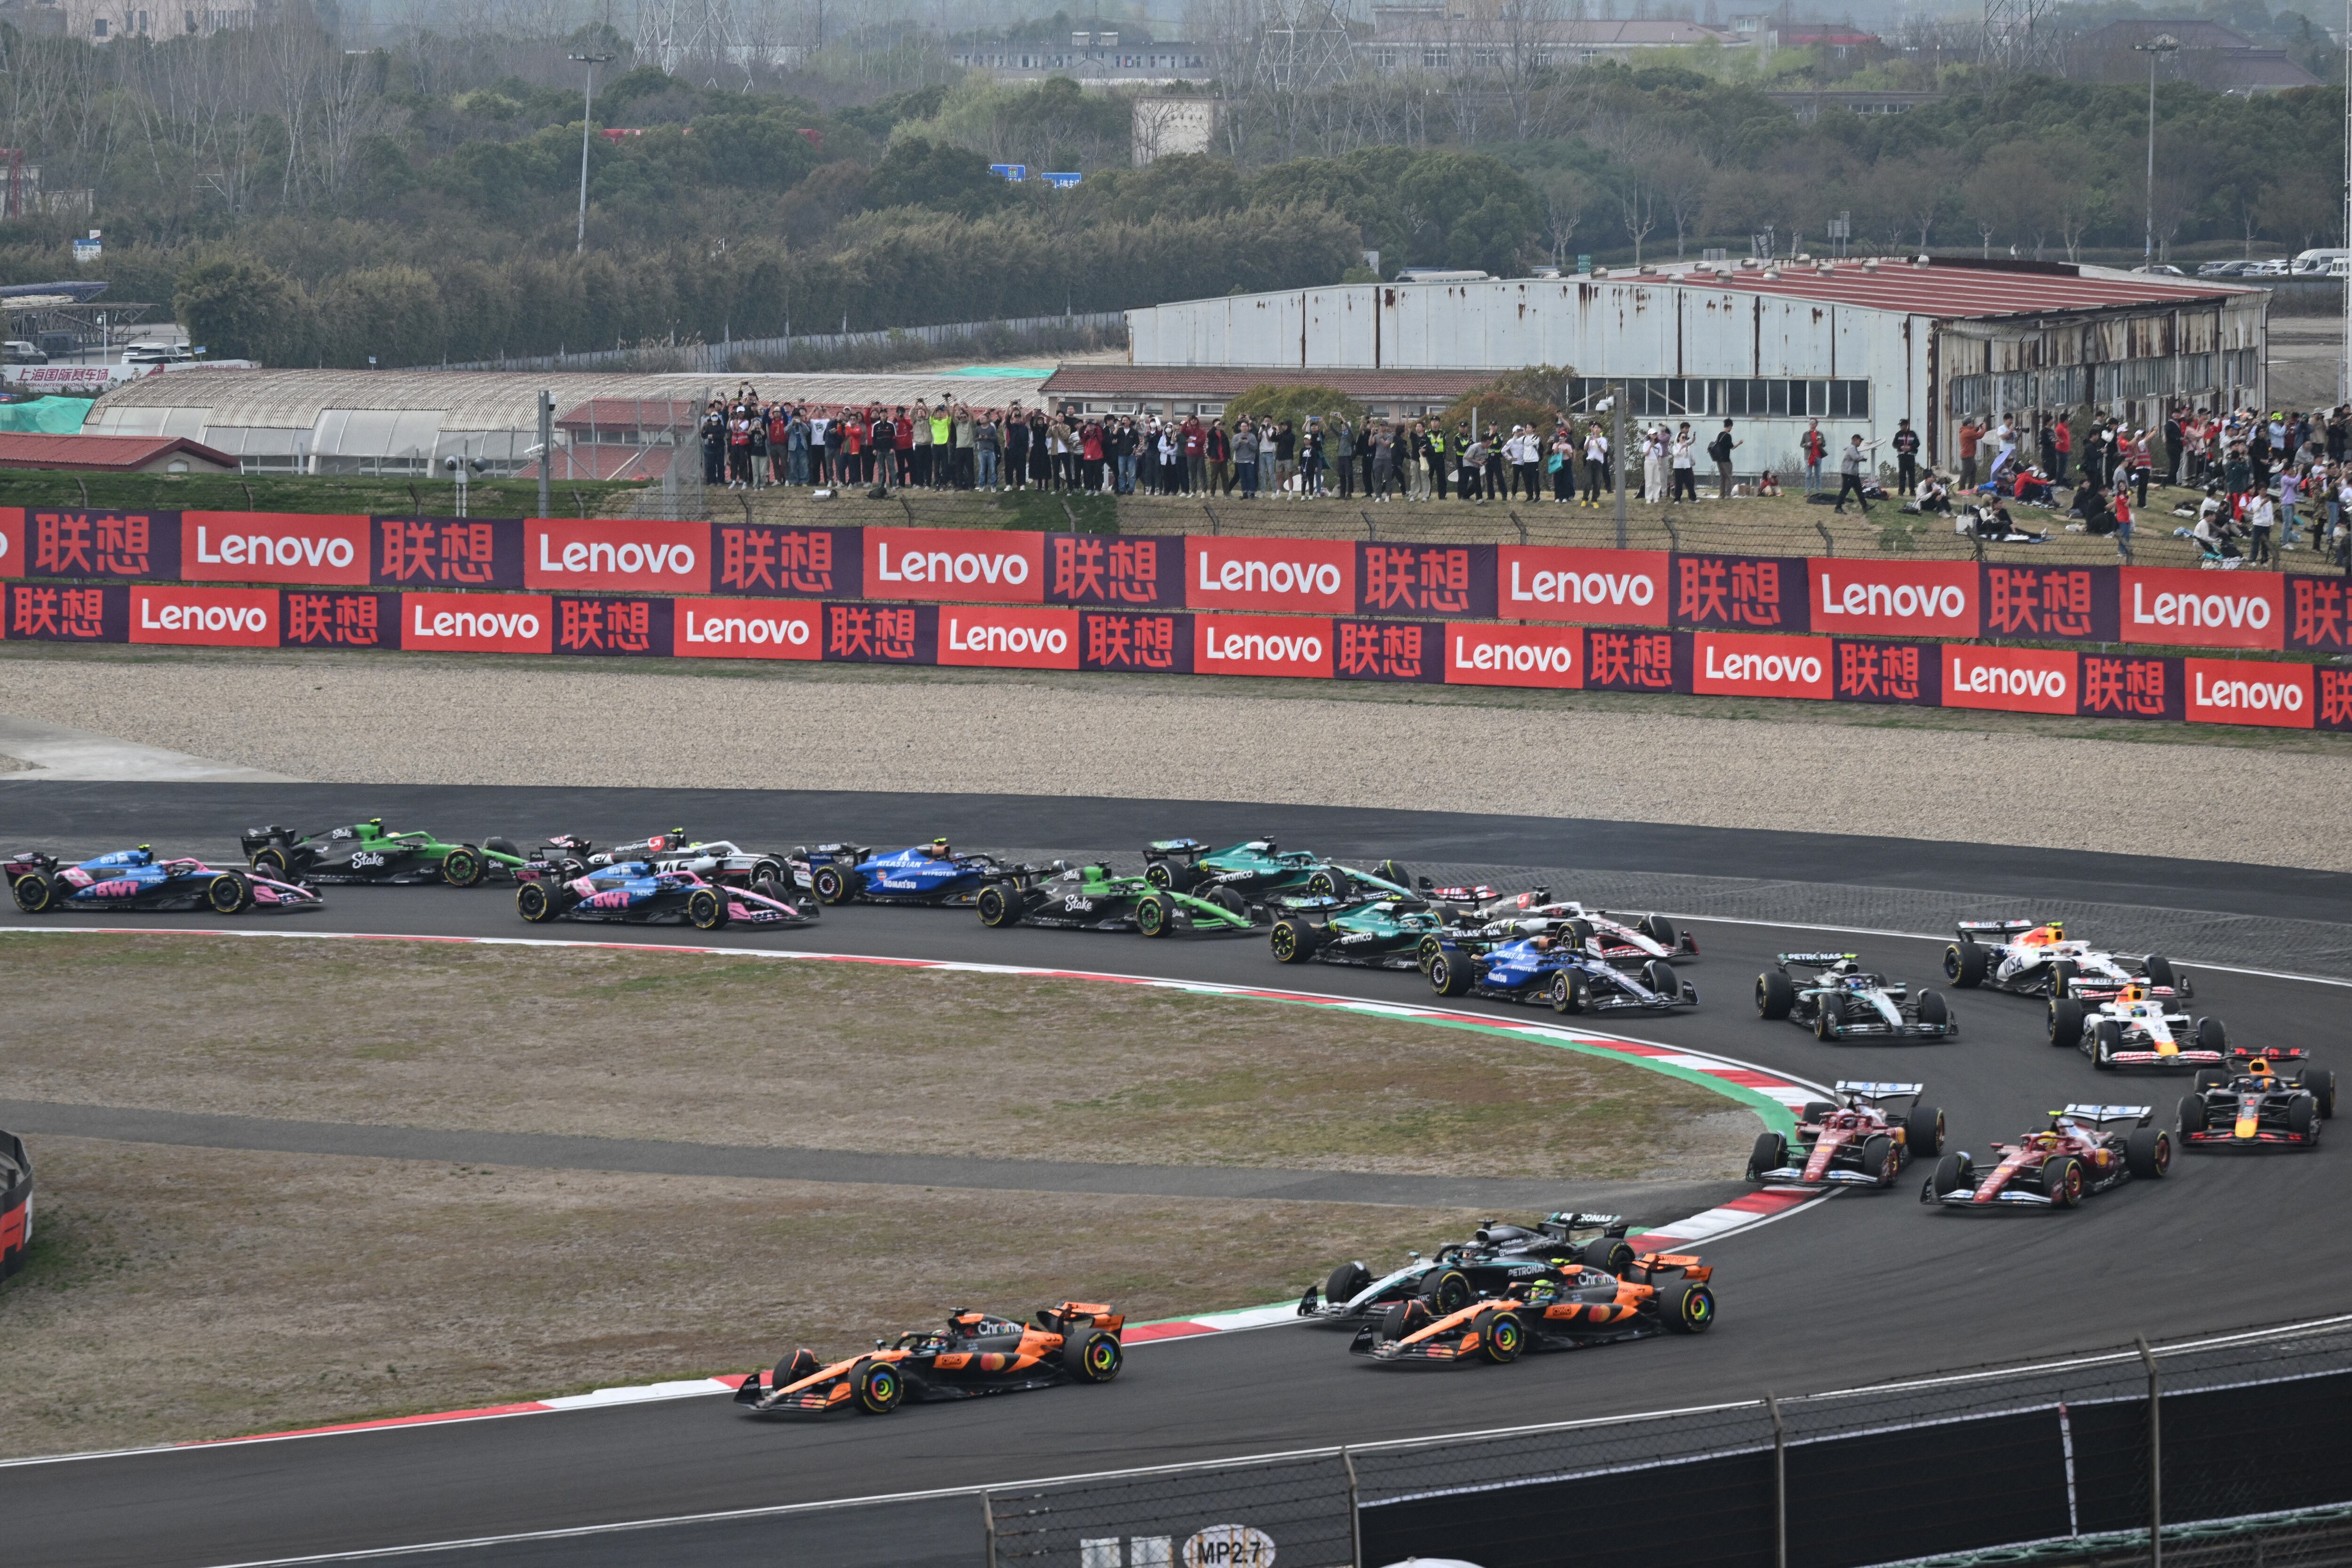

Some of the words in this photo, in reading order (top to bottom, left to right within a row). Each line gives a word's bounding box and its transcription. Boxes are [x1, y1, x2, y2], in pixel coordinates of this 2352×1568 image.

[16, 368, 109, 382] 上海国际赛车场
[36, 515, 149, 573] 联想
[199, 527, 353, 567] Lenovo
[382, 522, 493, 581] 联想
[541, 534, 694, 573] Lenovo
[723, 530, 832, 592] 联想
[880, 543, 1028, 584] Lenovo
[1054, 539, 1157, 602] 联想
[1200, 552, 1340, 594] Lenovo
[1366, 548, 1468, 611] 联想
[1512, 562, 1653, 605] Lenovo
[1678, 559, 1780, 625] 联想
[1822, 574, 1964, 617] Lenovo
[14, 588, 103, 636] 联想
[143, 599, 266, 631] Lenovo
[289, 595, 378, 644] 联想
[1989, 569, 2090, 635] 联想
[2135, 584, 2269, 629] Lenovo
[2293, 580, 2352, 646] 联
[415, 605, 539, 638] Lenovo
[561, 601, 649, 650] 联想
[687, 612, 809, 644] Lenovo
[830, 607, 914, 658] 联想
[950, 619, 1066, 653] Lenovo
[1088, 616, 1173, 667] 联想
[1208, 628, 1321, 661] Lenovo
[1340, 624, 1422, 677] 联想
[1456, 637, 1571, 672] Lenovo
[1590, 634, 1672, 686] 联想
[1707, 647, 1821, 682] Lenovo
[1840, 644, 1919, 699] 联想
[1955, 659, 2065, 697] Lenovo
[2084, 658, 2164, 714] 联想
[2197, 673, 2302, 710] Lenovo
[332, 828, 352, 839] Stake
[615, 843, 648, 852] MoneyGram
[100, 855, 116, 864] eni
[352, 852, 385, 869] Stake
[607, 866, 621, 875] eni
[1063, 870, 1081, 881] Stake
[1218, 870, 1253, 883] aramco
[95, 881, 140, 897] BWT
[594, 892, 631, 908] BWT
[883, 879, 917, 889] KOMATSU
[1065, 894, 1093, 912] Stake
[1341, 932, 1373, 945] aramco
[1494, 950, 1526, 961] ATLASSIAN
[1487, 972, 1508, 983] KOMATSU
[1510, 964, 1538, 973] MYPROTEIN
[2003, 956, 2025, 976] VISA
[2115, 1052, 2153, 1061] HUGO
[1507, 1264, 1545, 1277] PETRONAS
[1578, 1272, 1618, 1286] Chrome
[978, 1321, 1023, 1335] Chrome
[1198, 1541, 1261, 1564] MP2.7
